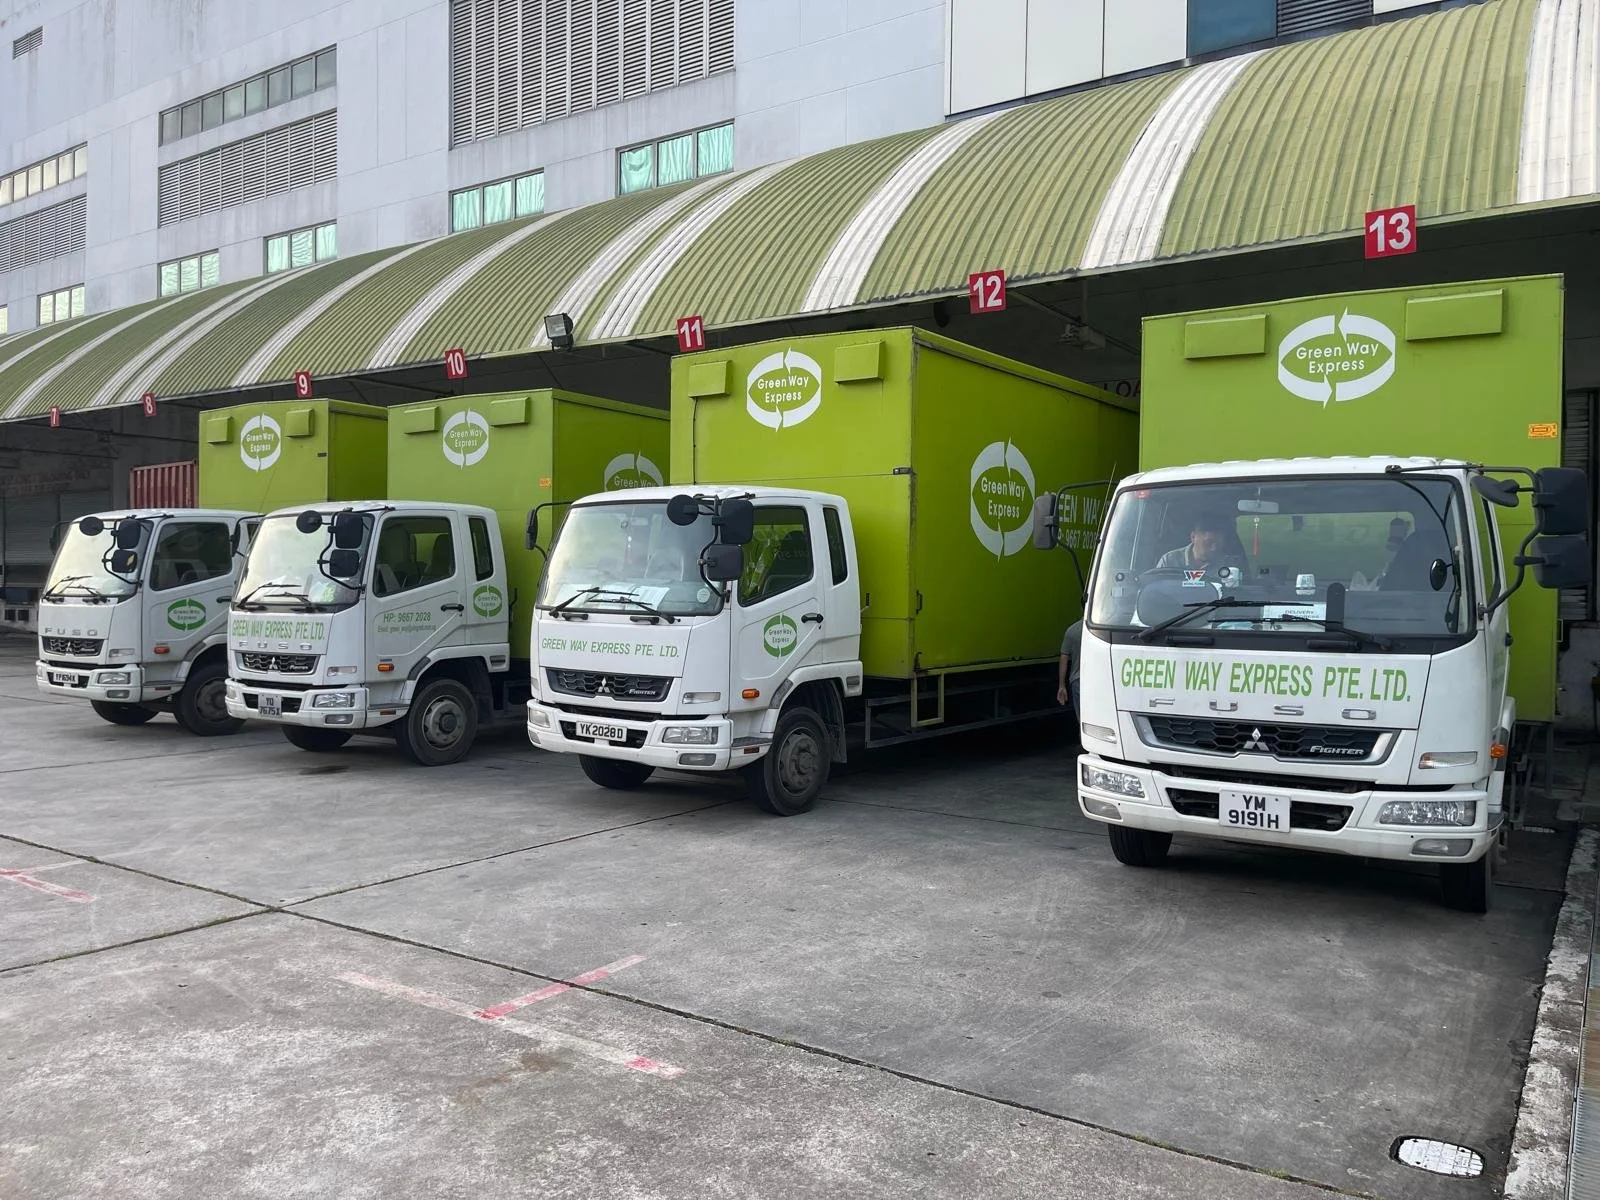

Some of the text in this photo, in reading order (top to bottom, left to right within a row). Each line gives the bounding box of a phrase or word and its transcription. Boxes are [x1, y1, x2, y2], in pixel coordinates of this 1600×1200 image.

[1369, 212, 1411, 252] 13
[973, 275, 1002, 308] 12
[680, 319, 702, 348] 11
[1296, 342, 1379, 359] Green Way
[447, 352, 464, 376] 10
[1308, 359, 1365, 375] Express
[299, 374, 308, 395] 9
[757, 375, 809, 389] Green Way
[145, 396, 153, 414] 8
[765, 391, 802, 405] Express
[450, 428, 482, 439] Green Way
[455, 439, 477, 448] Express
[614, 476, 638, 489] Green
[981, 476, 1026, 502] Green Way
[988, 499, 1020, 519] Express
[415, 611, 431, 622] 2028
[44, 627, 98, 637] FUSO
[232, 620, 248, 637] GREEN
[251, 620, 264, 637] WAY
[265, 620, 293, 639] EXPRESS
[239, 641, 312, 650] FUSO
[541, 637, 680, 658] GREEN WAY EXPRESS PTE. LTD.
[1121, 658, 1411, 702] GREEN WAY EXPRESS PTE. LTD.
[1149, 698, 1377, 720] FUSO
[580, 723, 623, 739] YK2028D
[1309, 745, 1364, 755] FIGHTER
[1242, 795, 1266, 811] YM
[1228, 809, 1279, 829] 9191H
